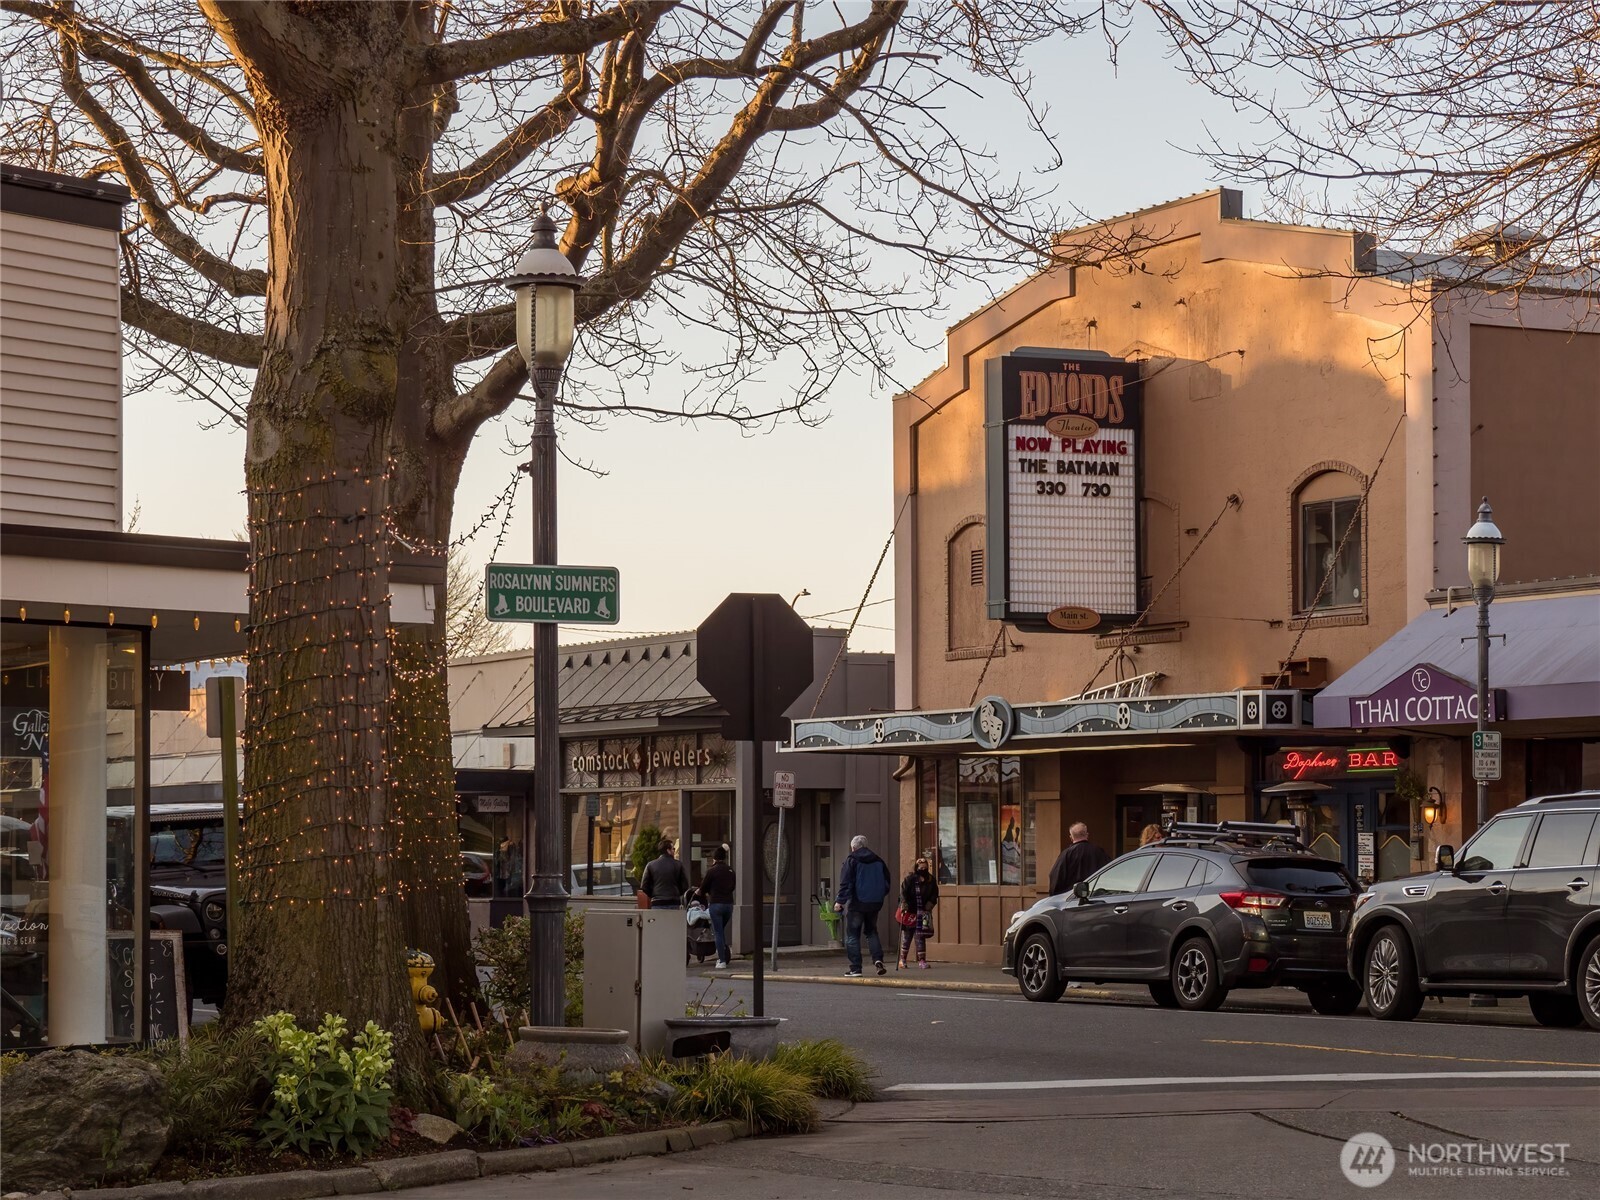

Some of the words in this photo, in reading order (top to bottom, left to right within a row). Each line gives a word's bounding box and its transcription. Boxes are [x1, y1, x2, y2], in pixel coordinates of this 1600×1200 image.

[1062, 362, 1080, 371] THE
[1019, 370, 1125, 424] EDMONDS
[1056, 419, 1093, 432] Theater
[1015, 436, 1052, 452] NOW
[1061, 438, 1127, 456] PLAYING
[1018, 458, 1048, 473] THE
[1056, 460, 1120, 477] BATMAN
[1036, 480, 1066, 496] 330
[1081, 482, 1112, 498] 730
[489, 572, 552, 591] ROSALYNN
[555, 574, 617, 593] SUMNERS
[515, 595, 591, 615] BOULEVARD
[1059, 610, 1078, 620] Main
[1355, 698, 1399, 724] THAI
[1405, 693, 1492, 722] COTTAG
[1475, 734, 1482, 747] 3
[571, 747, 631, 772] comstock
[646, 743, 711, 773] jewelers
[1348, 752, 1398, 768] BAR
[775, 782, 796, 790] PARKING
[781, 774, 790, 782] NO
[152, 889, 186, 899] RUBICON
[20, 936, 37, 945] GEAR
